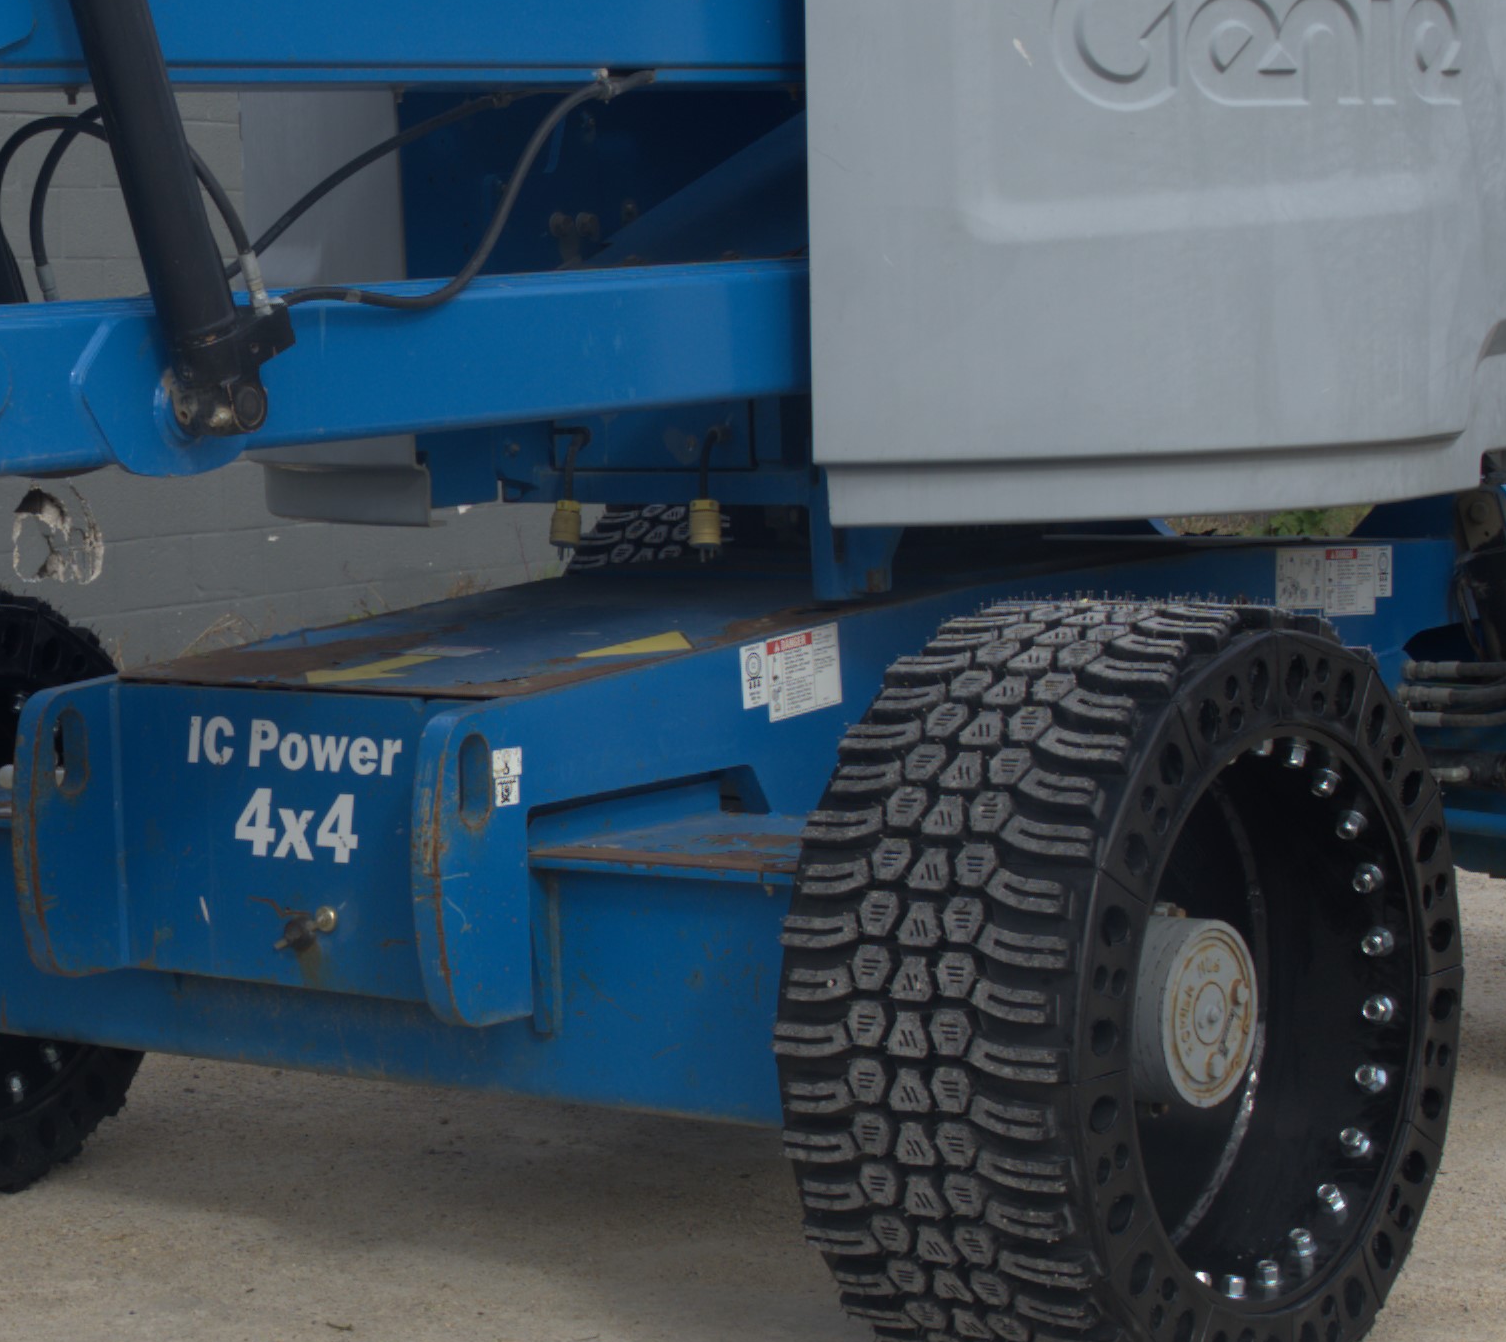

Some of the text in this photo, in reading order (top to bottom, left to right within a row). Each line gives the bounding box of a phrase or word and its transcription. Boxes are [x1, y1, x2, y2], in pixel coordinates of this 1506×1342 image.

[187, 715, 403, 777] IC Power
[234, 787, 359, 864] 4x4
